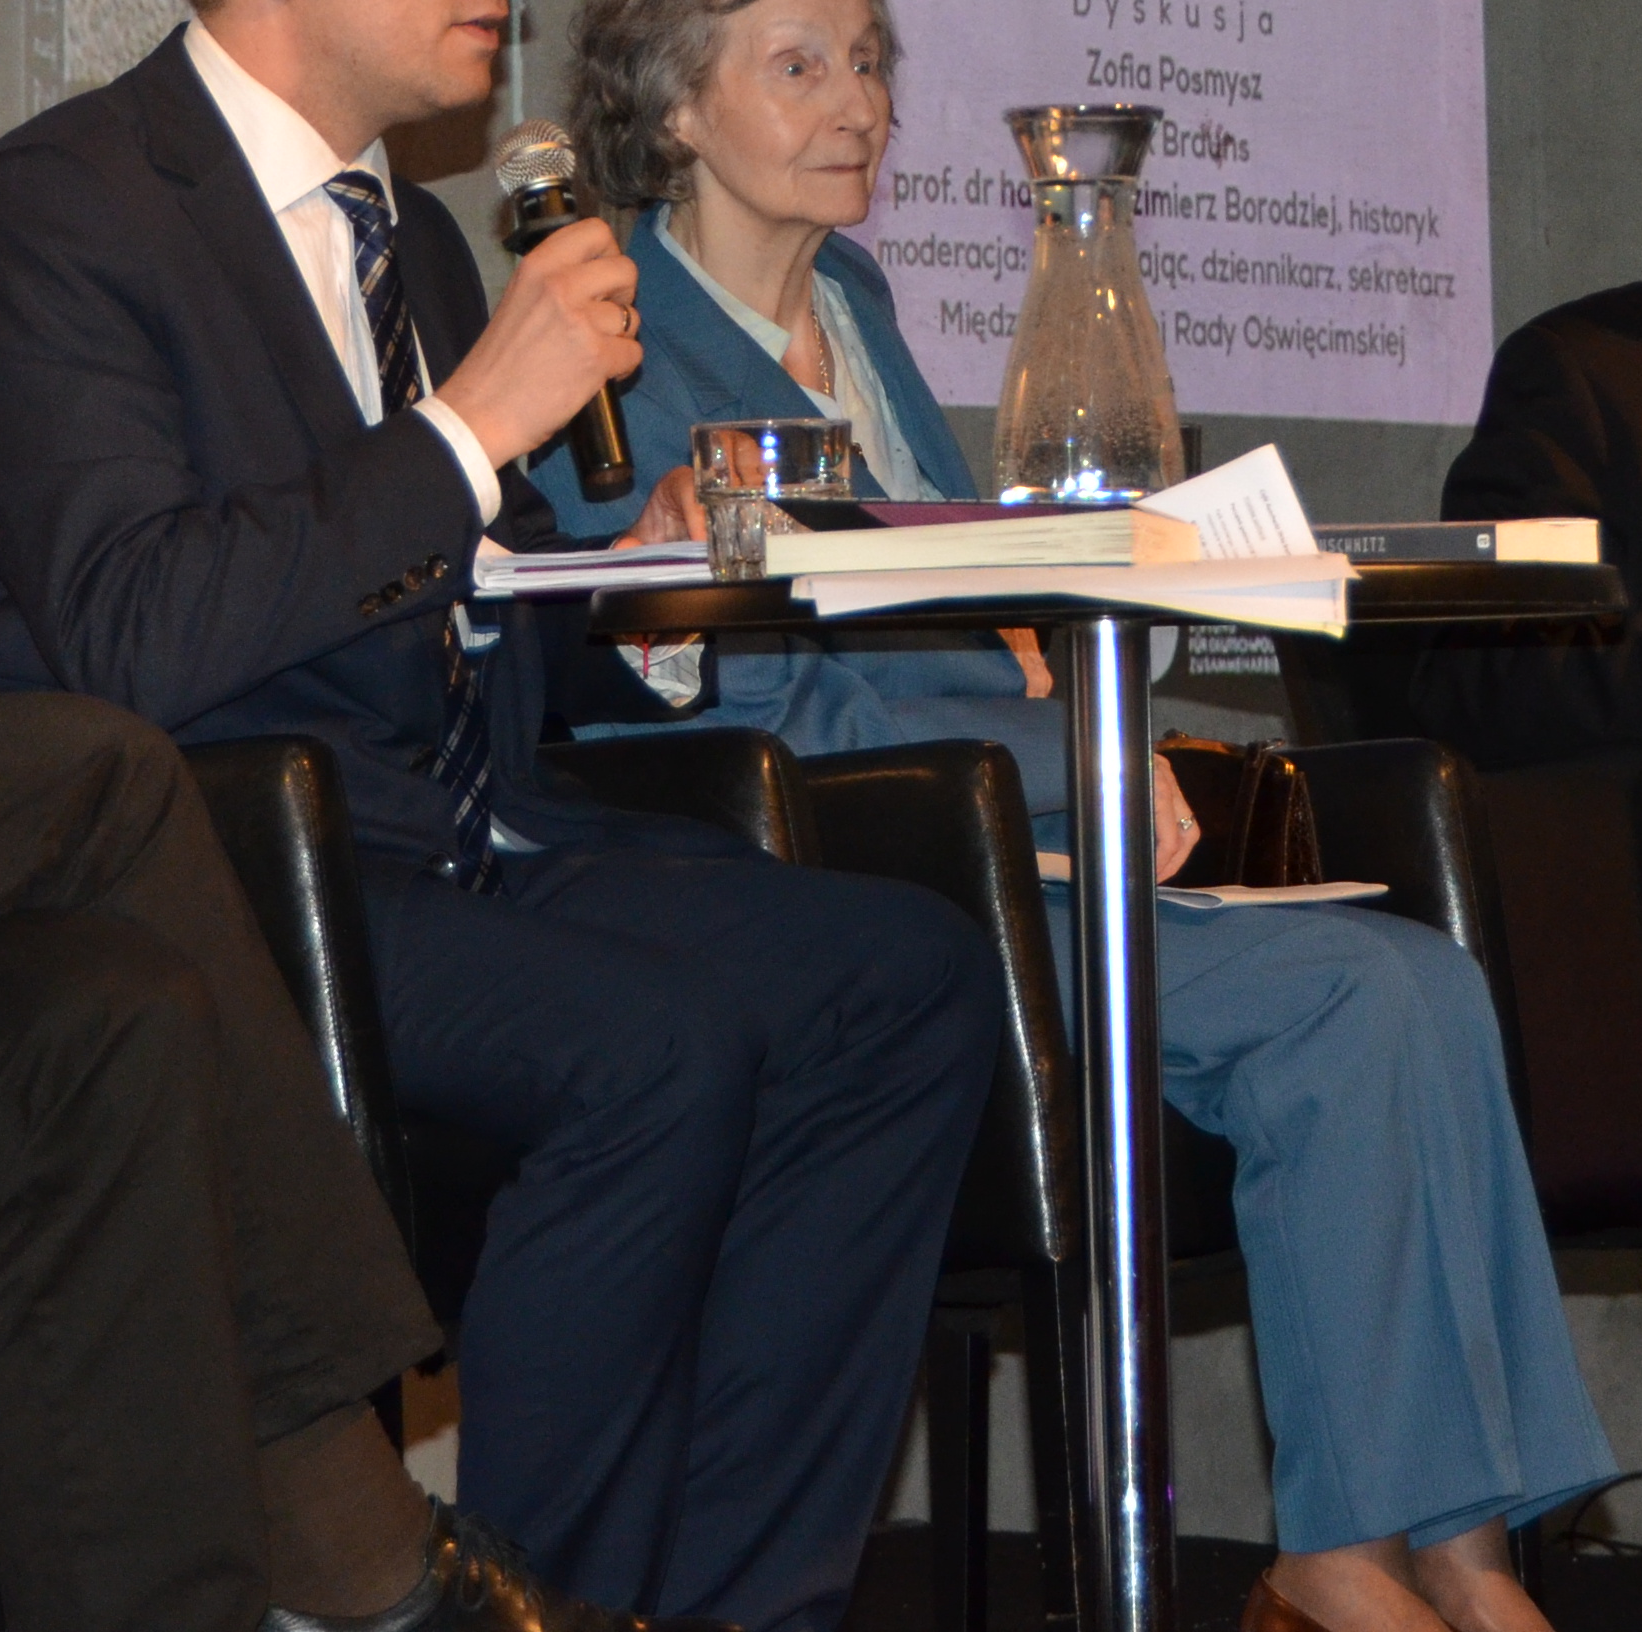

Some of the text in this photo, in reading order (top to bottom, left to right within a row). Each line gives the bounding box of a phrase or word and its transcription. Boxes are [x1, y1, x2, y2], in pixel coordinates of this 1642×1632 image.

[1086, 48, 1264, 107] Zofia Posmysz
[1163, 119, 1251, 164] Brauns
[893, 166, 958, 210] prof.
[964, 168, 996, 206] dr
[1224, 186, 1343, 238] Borodziej,
[1349, 200, 1440, 244] historyk
[879, 234, 1456, 300] moderacja: ając, dziennikarz, sekretarz
[1173, 311, 1237, 356] Rady
[1243, 312, 1407, 368] Oświęcimskiej
[1318, 536, 1386, 553] USCHWITZ
